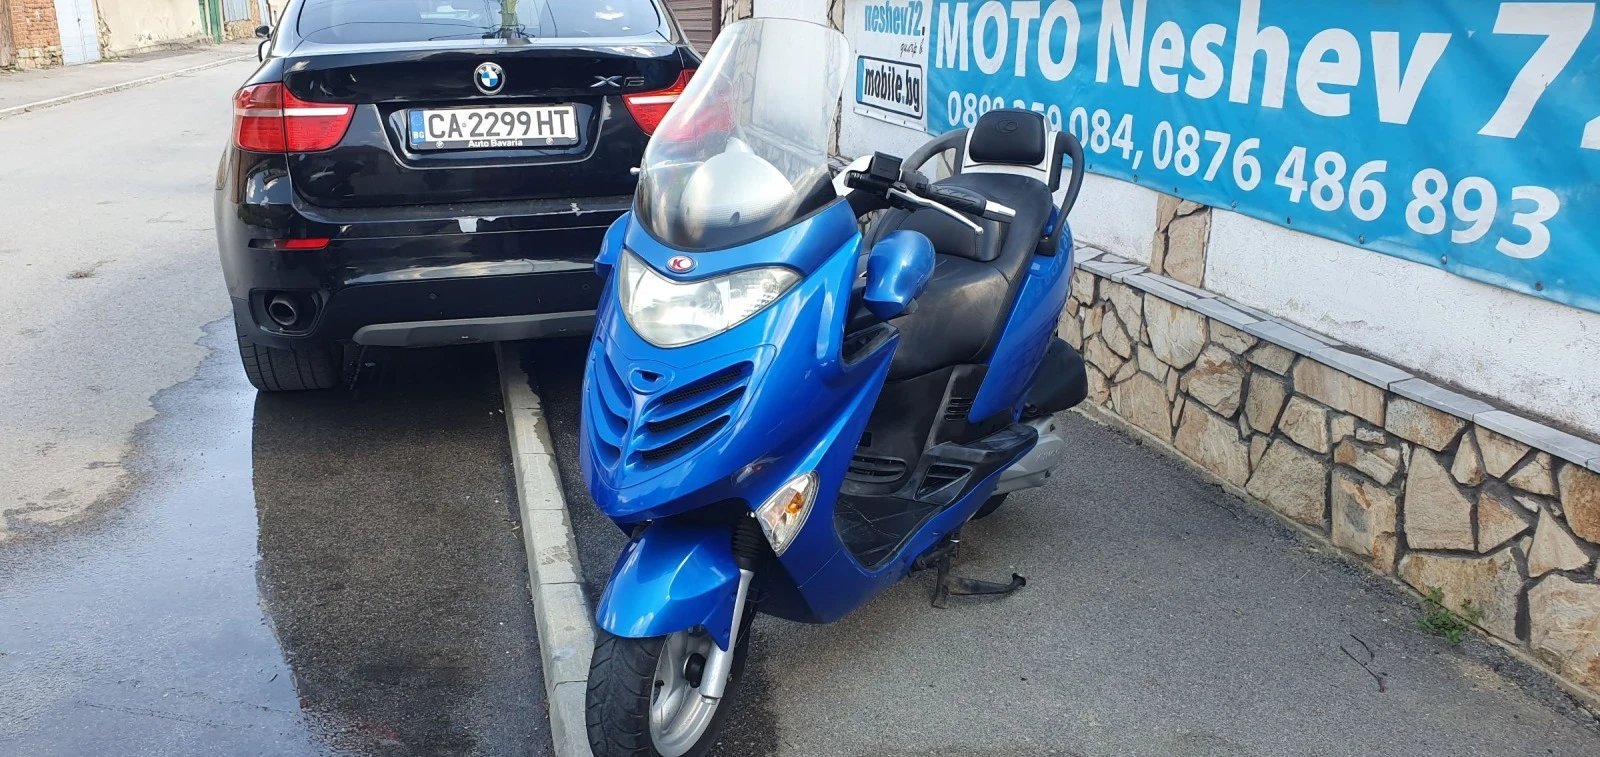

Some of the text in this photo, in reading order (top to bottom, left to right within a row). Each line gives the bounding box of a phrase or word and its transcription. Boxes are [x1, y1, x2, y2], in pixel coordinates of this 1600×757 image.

[864, 64, 920, 112] mobile.bg
[935, 0, 1600, 150] MOTO Neshev 7
[413, 131, 425, 139] BG
[428, 110, 569, 138] CA 2299 HT
[468, 138, 523, 148] Auto Bavaria
[1069, 106, 1143, 170] 084,
[1152, 120, 1261, 191] 0876
[1275, 145, 1388, 221] 486
[1405, 168, 1560, 259] 893
